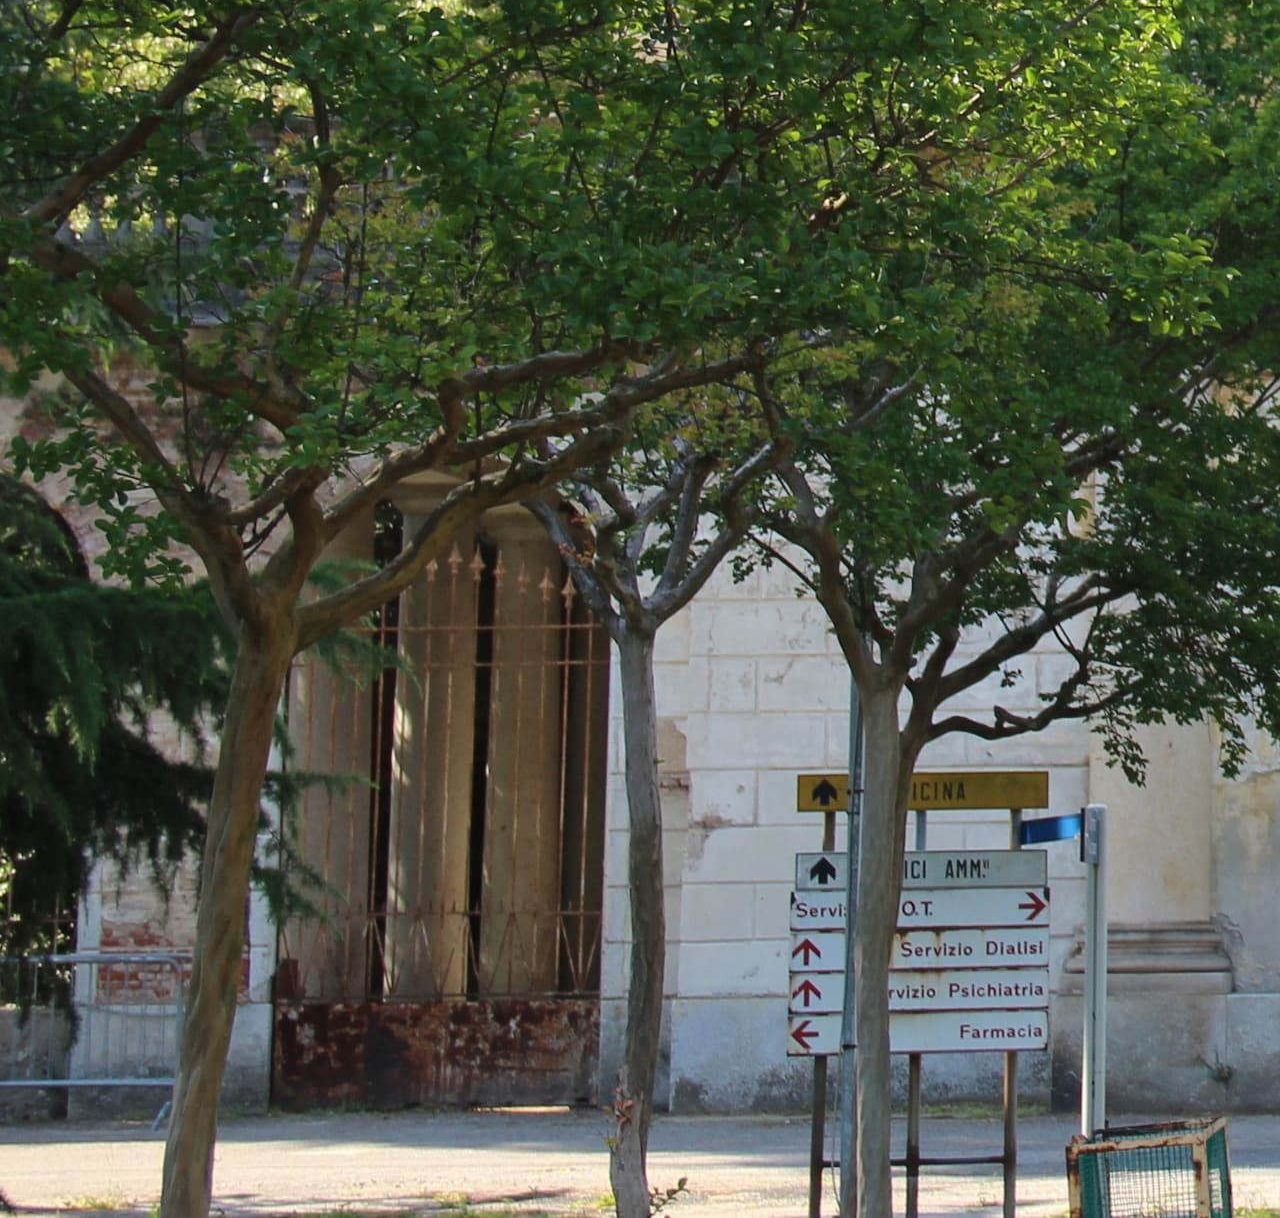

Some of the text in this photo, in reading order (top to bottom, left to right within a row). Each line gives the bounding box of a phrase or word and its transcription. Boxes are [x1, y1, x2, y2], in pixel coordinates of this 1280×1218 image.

[912, 781, 966, 801] ICINA
[904, 860, 926, 879] ICI
[796, 902, 848, 918] Servi
[901, 940, 1043, 958] Servizio Dialisi
[888, 982, 1043, 999] rvizio Psichiatria
[960, 1024, 1043, 1039] Farmacia
